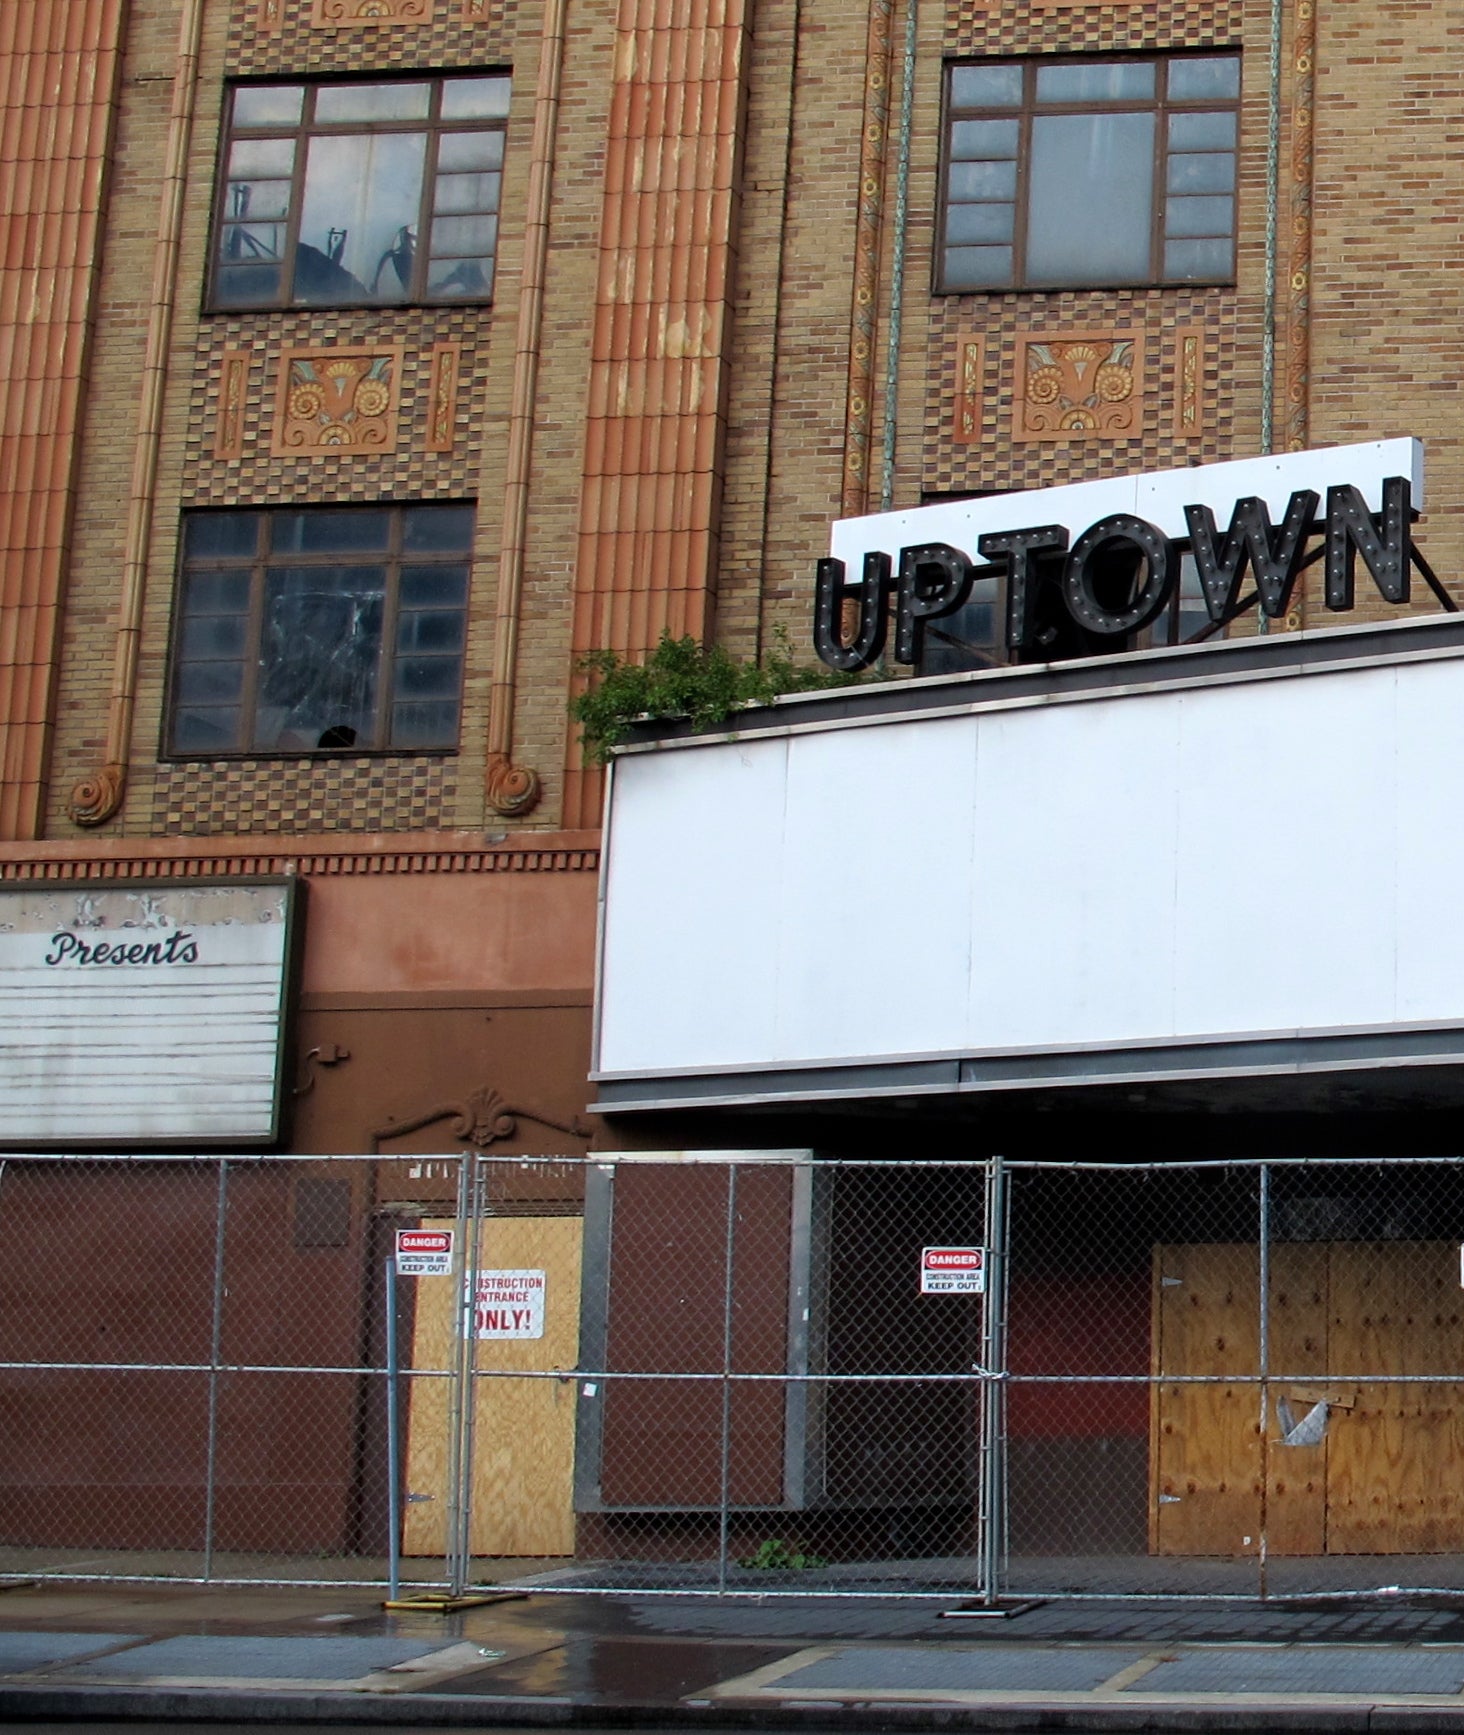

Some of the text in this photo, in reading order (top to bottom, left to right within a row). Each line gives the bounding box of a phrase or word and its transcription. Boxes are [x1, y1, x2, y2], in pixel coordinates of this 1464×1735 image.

[814, 476, 1412, 673] UPTOWN
[45, 930, 200, 966] Presents
[403, 1238, 447, 1247] DANGER
[928, 1254, 977, 1265] DANGER
[427, 1264, 446, 1272] OUT
[928, 1282, 978, 1290] KEEP OUT
[474, 1310, 531, 1330] ONLY!
